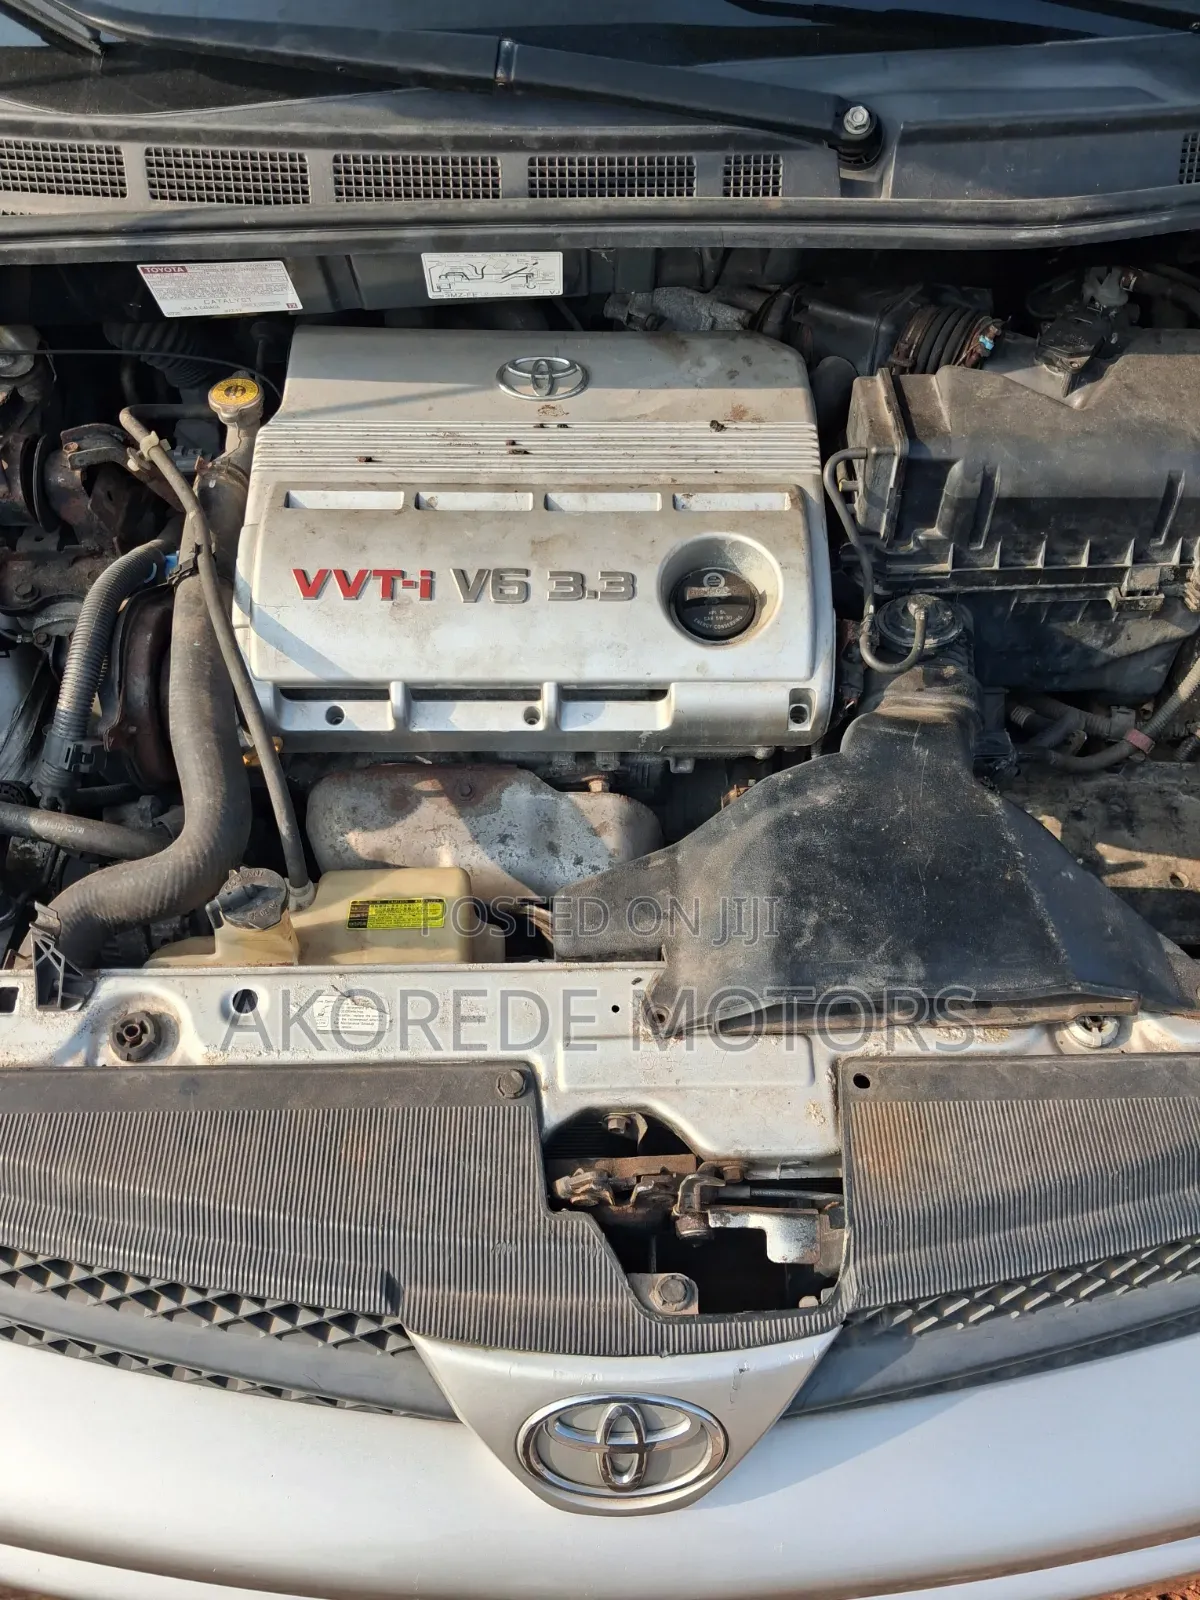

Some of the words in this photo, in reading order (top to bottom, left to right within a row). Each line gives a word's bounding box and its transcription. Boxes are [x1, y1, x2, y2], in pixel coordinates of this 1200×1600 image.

[143, 266, 186, 274] TOYOTA
[203, 297, 252, 305] CATALYST
[292, 568, 435, 602] VVT-i
[450, 568, 530, 604] V6
[546, 570, 635, 603] 3.3
[713, 615, 743, 630] CONSERVING
